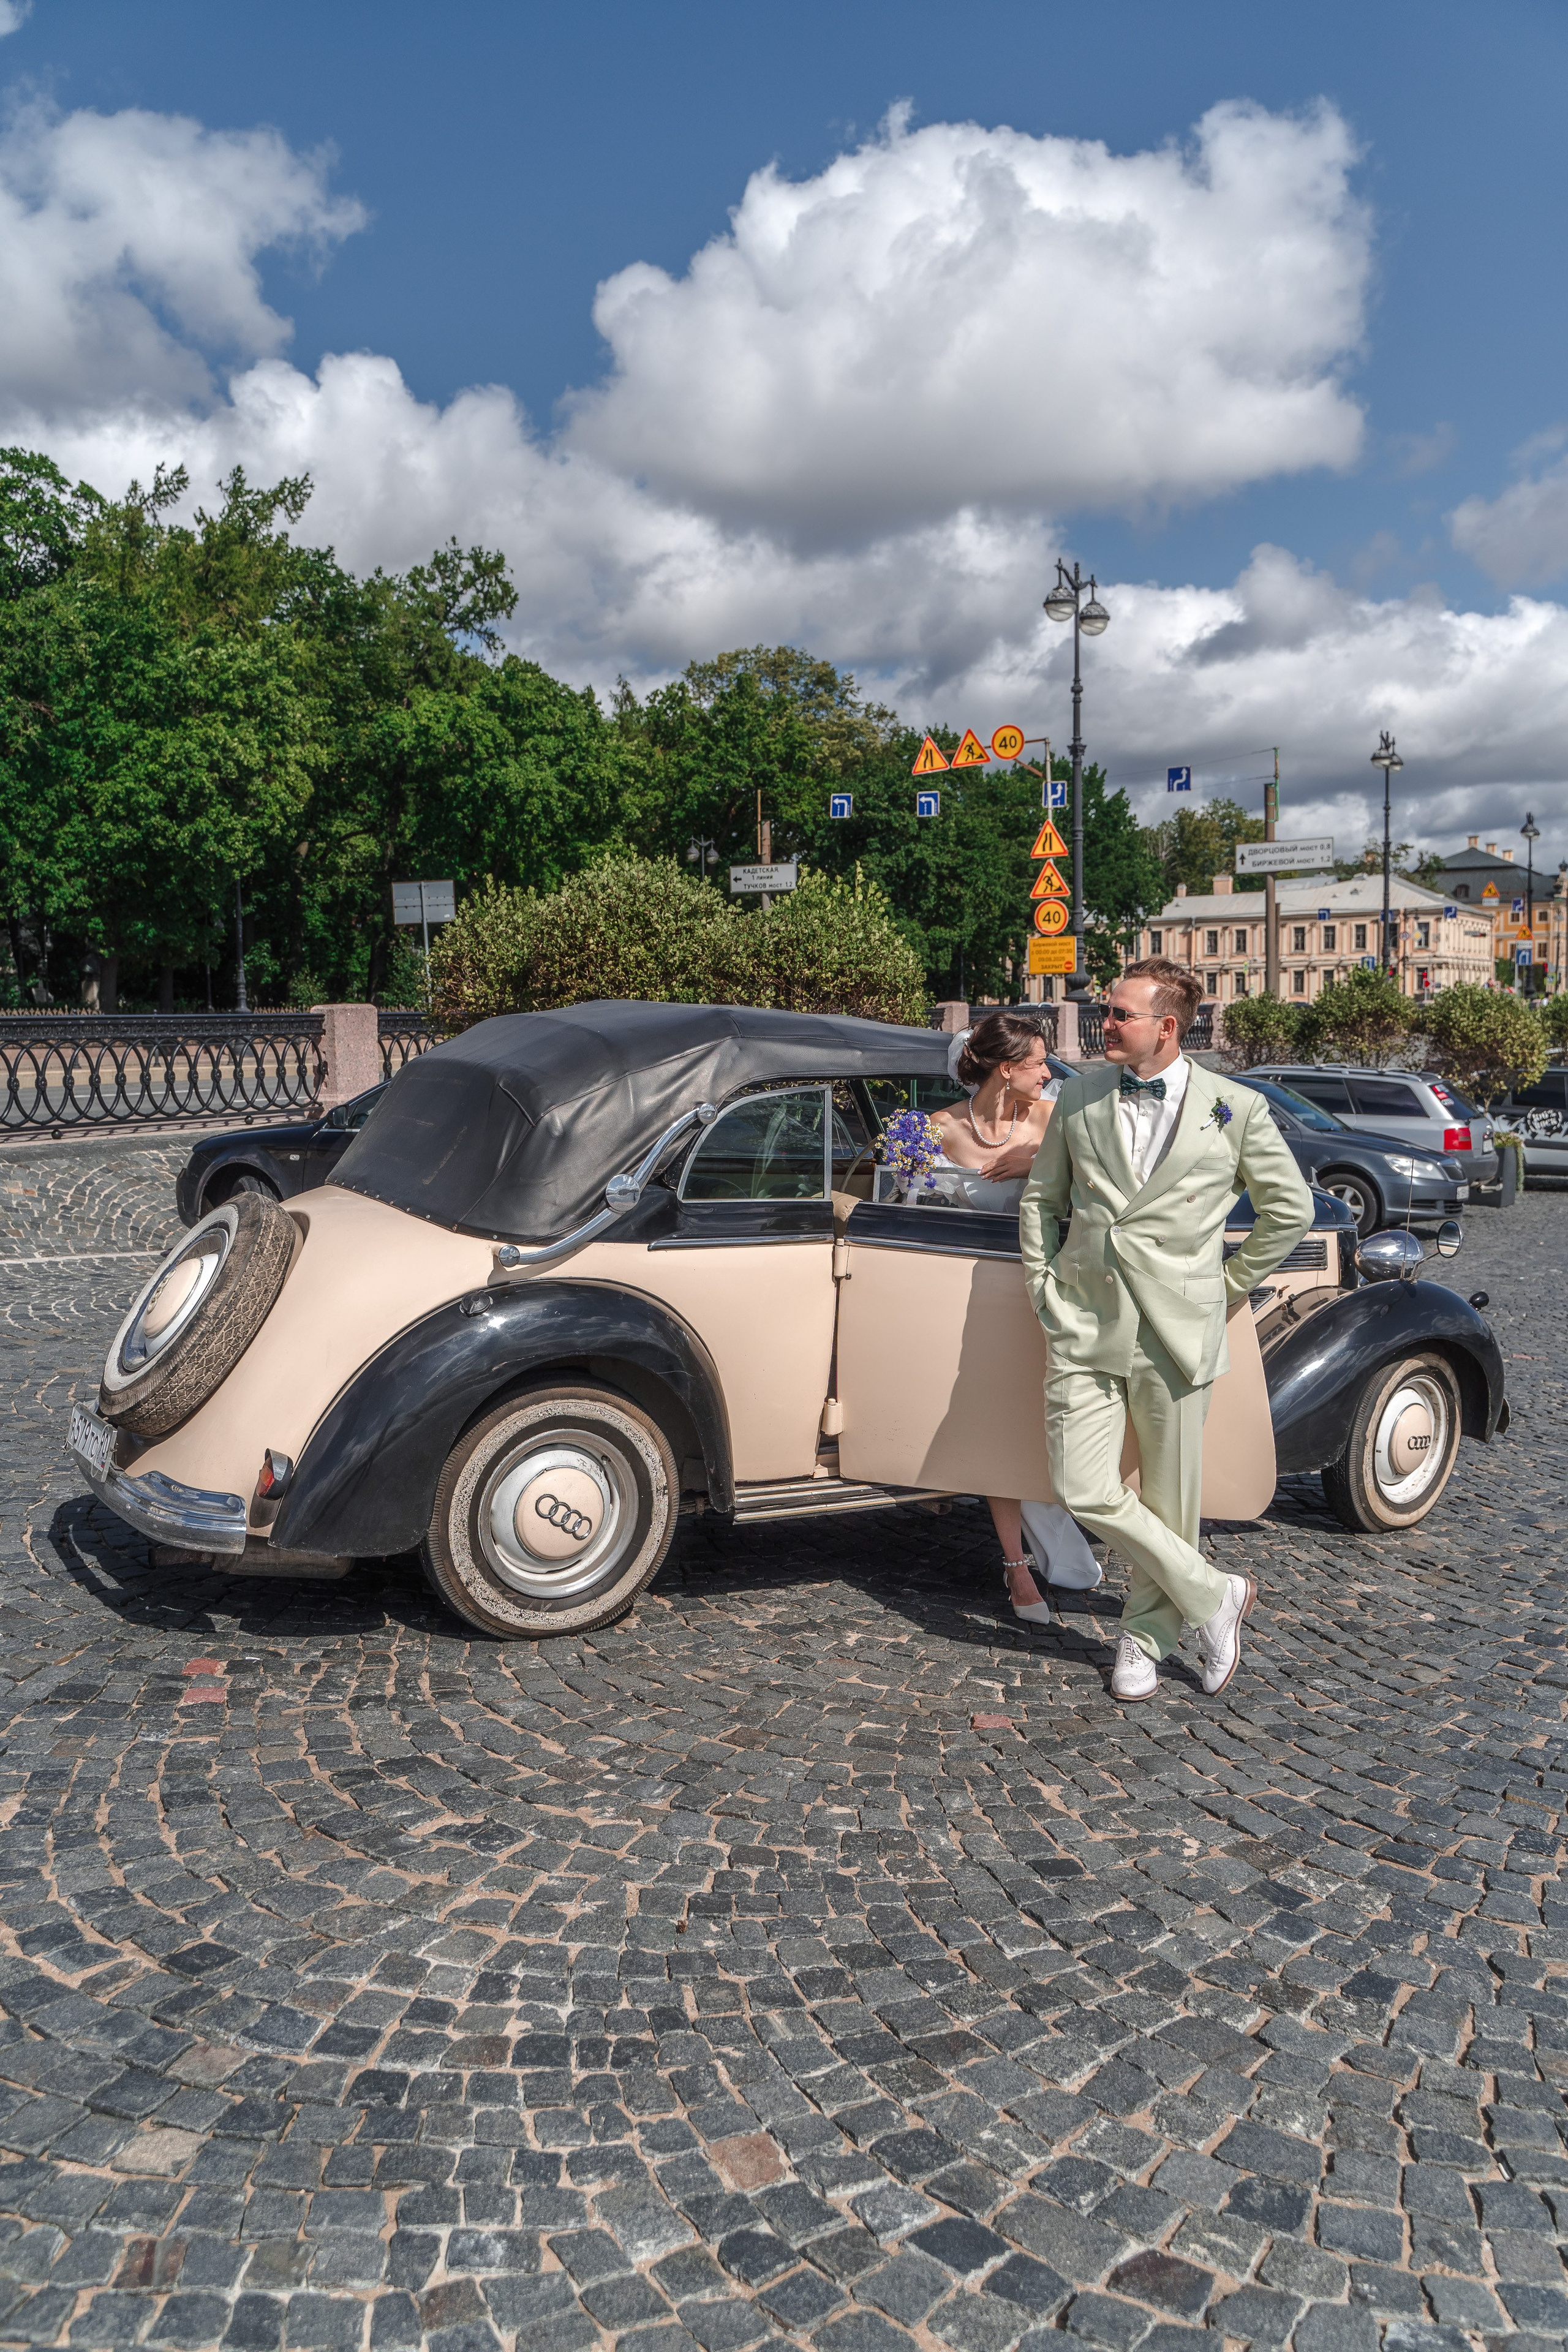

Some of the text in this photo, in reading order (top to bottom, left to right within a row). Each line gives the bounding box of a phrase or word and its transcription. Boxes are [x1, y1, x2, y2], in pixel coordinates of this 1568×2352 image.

[999, 736, 1017, 749] 40
[1248, 844, 1298, 856] ДВОРЦОВЫЙ
[1251, 857, 1294, 867] БИРЖЕВОЙ
[1042, 911, 1060, 924] 40
